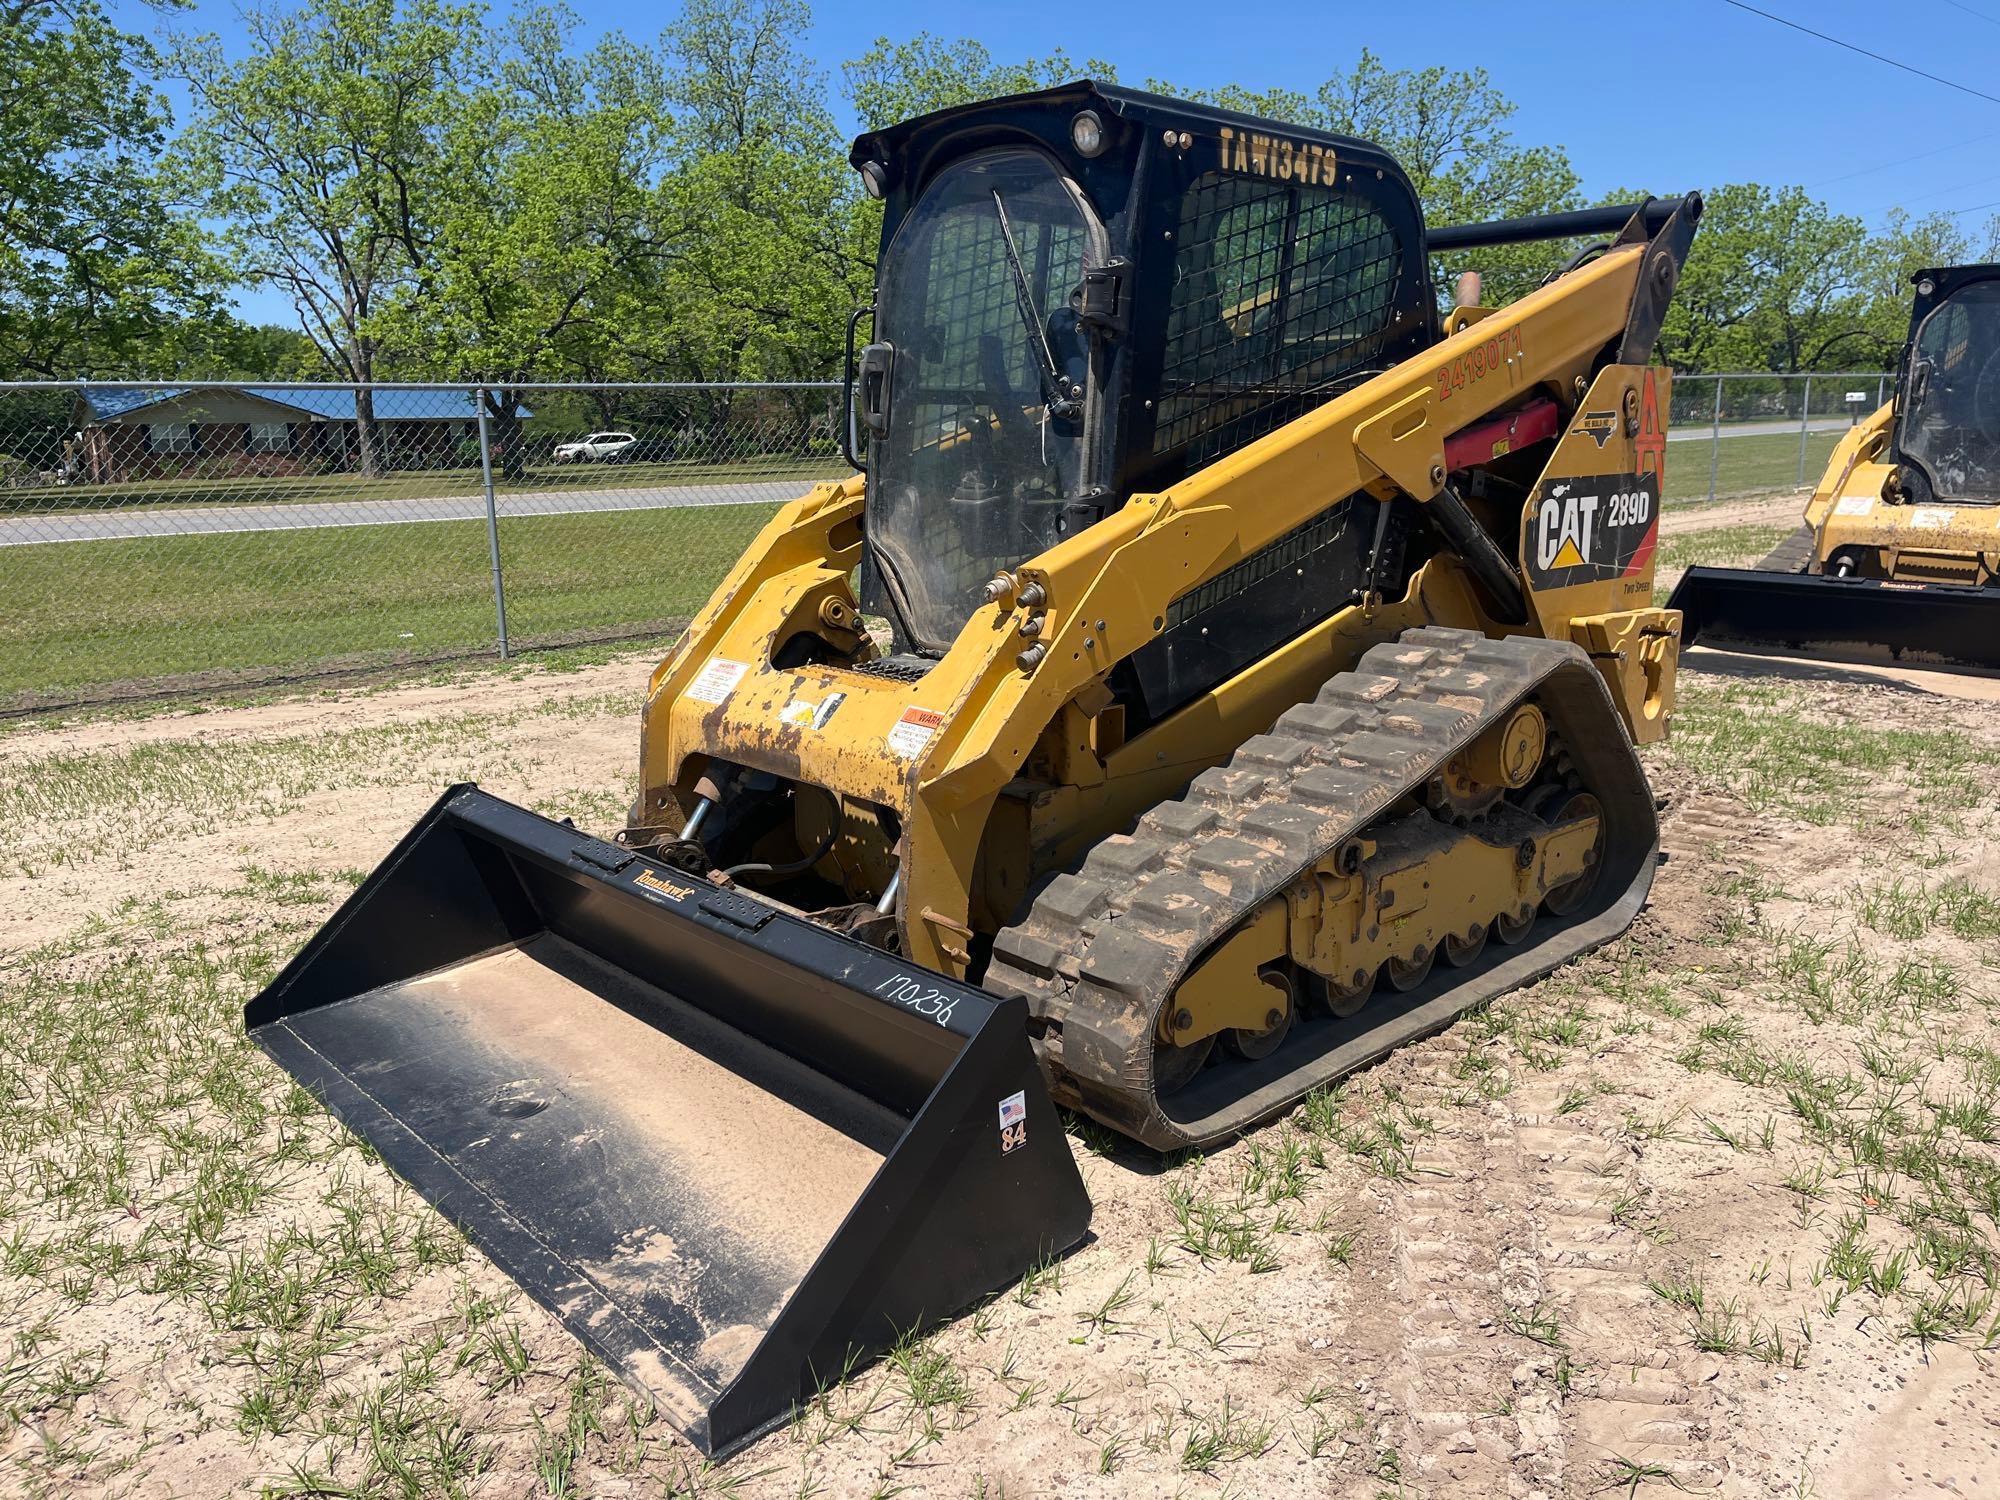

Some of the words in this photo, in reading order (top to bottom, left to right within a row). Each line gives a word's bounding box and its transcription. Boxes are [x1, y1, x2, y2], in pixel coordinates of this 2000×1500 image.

[1437, 323, 1524, 402] 2419071
[1537, 495, 1599, 571] CAT
[1607, 491, 1649, 528] 289D
[632, 869, 696, 900] Tomahawk
[875, 973, 960, 1028] 170256
[1001, 1120, 1027, 1152] 84
